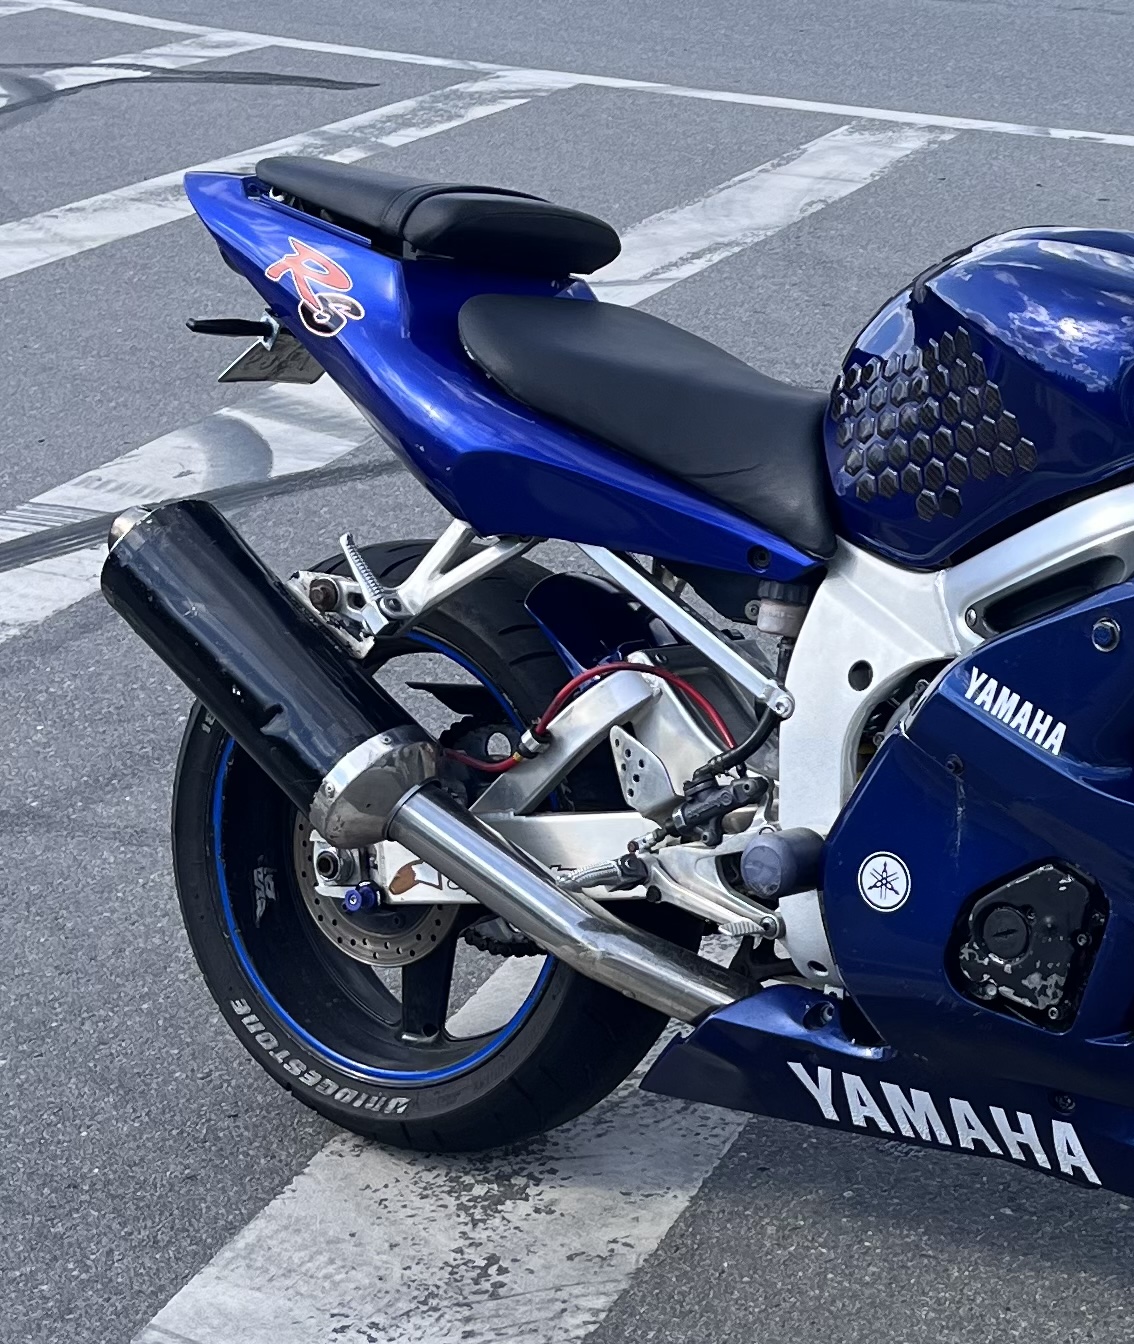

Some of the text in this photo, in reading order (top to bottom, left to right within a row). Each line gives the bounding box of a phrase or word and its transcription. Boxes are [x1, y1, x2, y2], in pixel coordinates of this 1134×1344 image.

[264, 236, 365, 338] R6
[964, 666, 1067, 756] YAMAHA
[229, 997, 412, 1115] BRIDGESTONE
[786, 1061, 1103, 1187] YAMAHA
